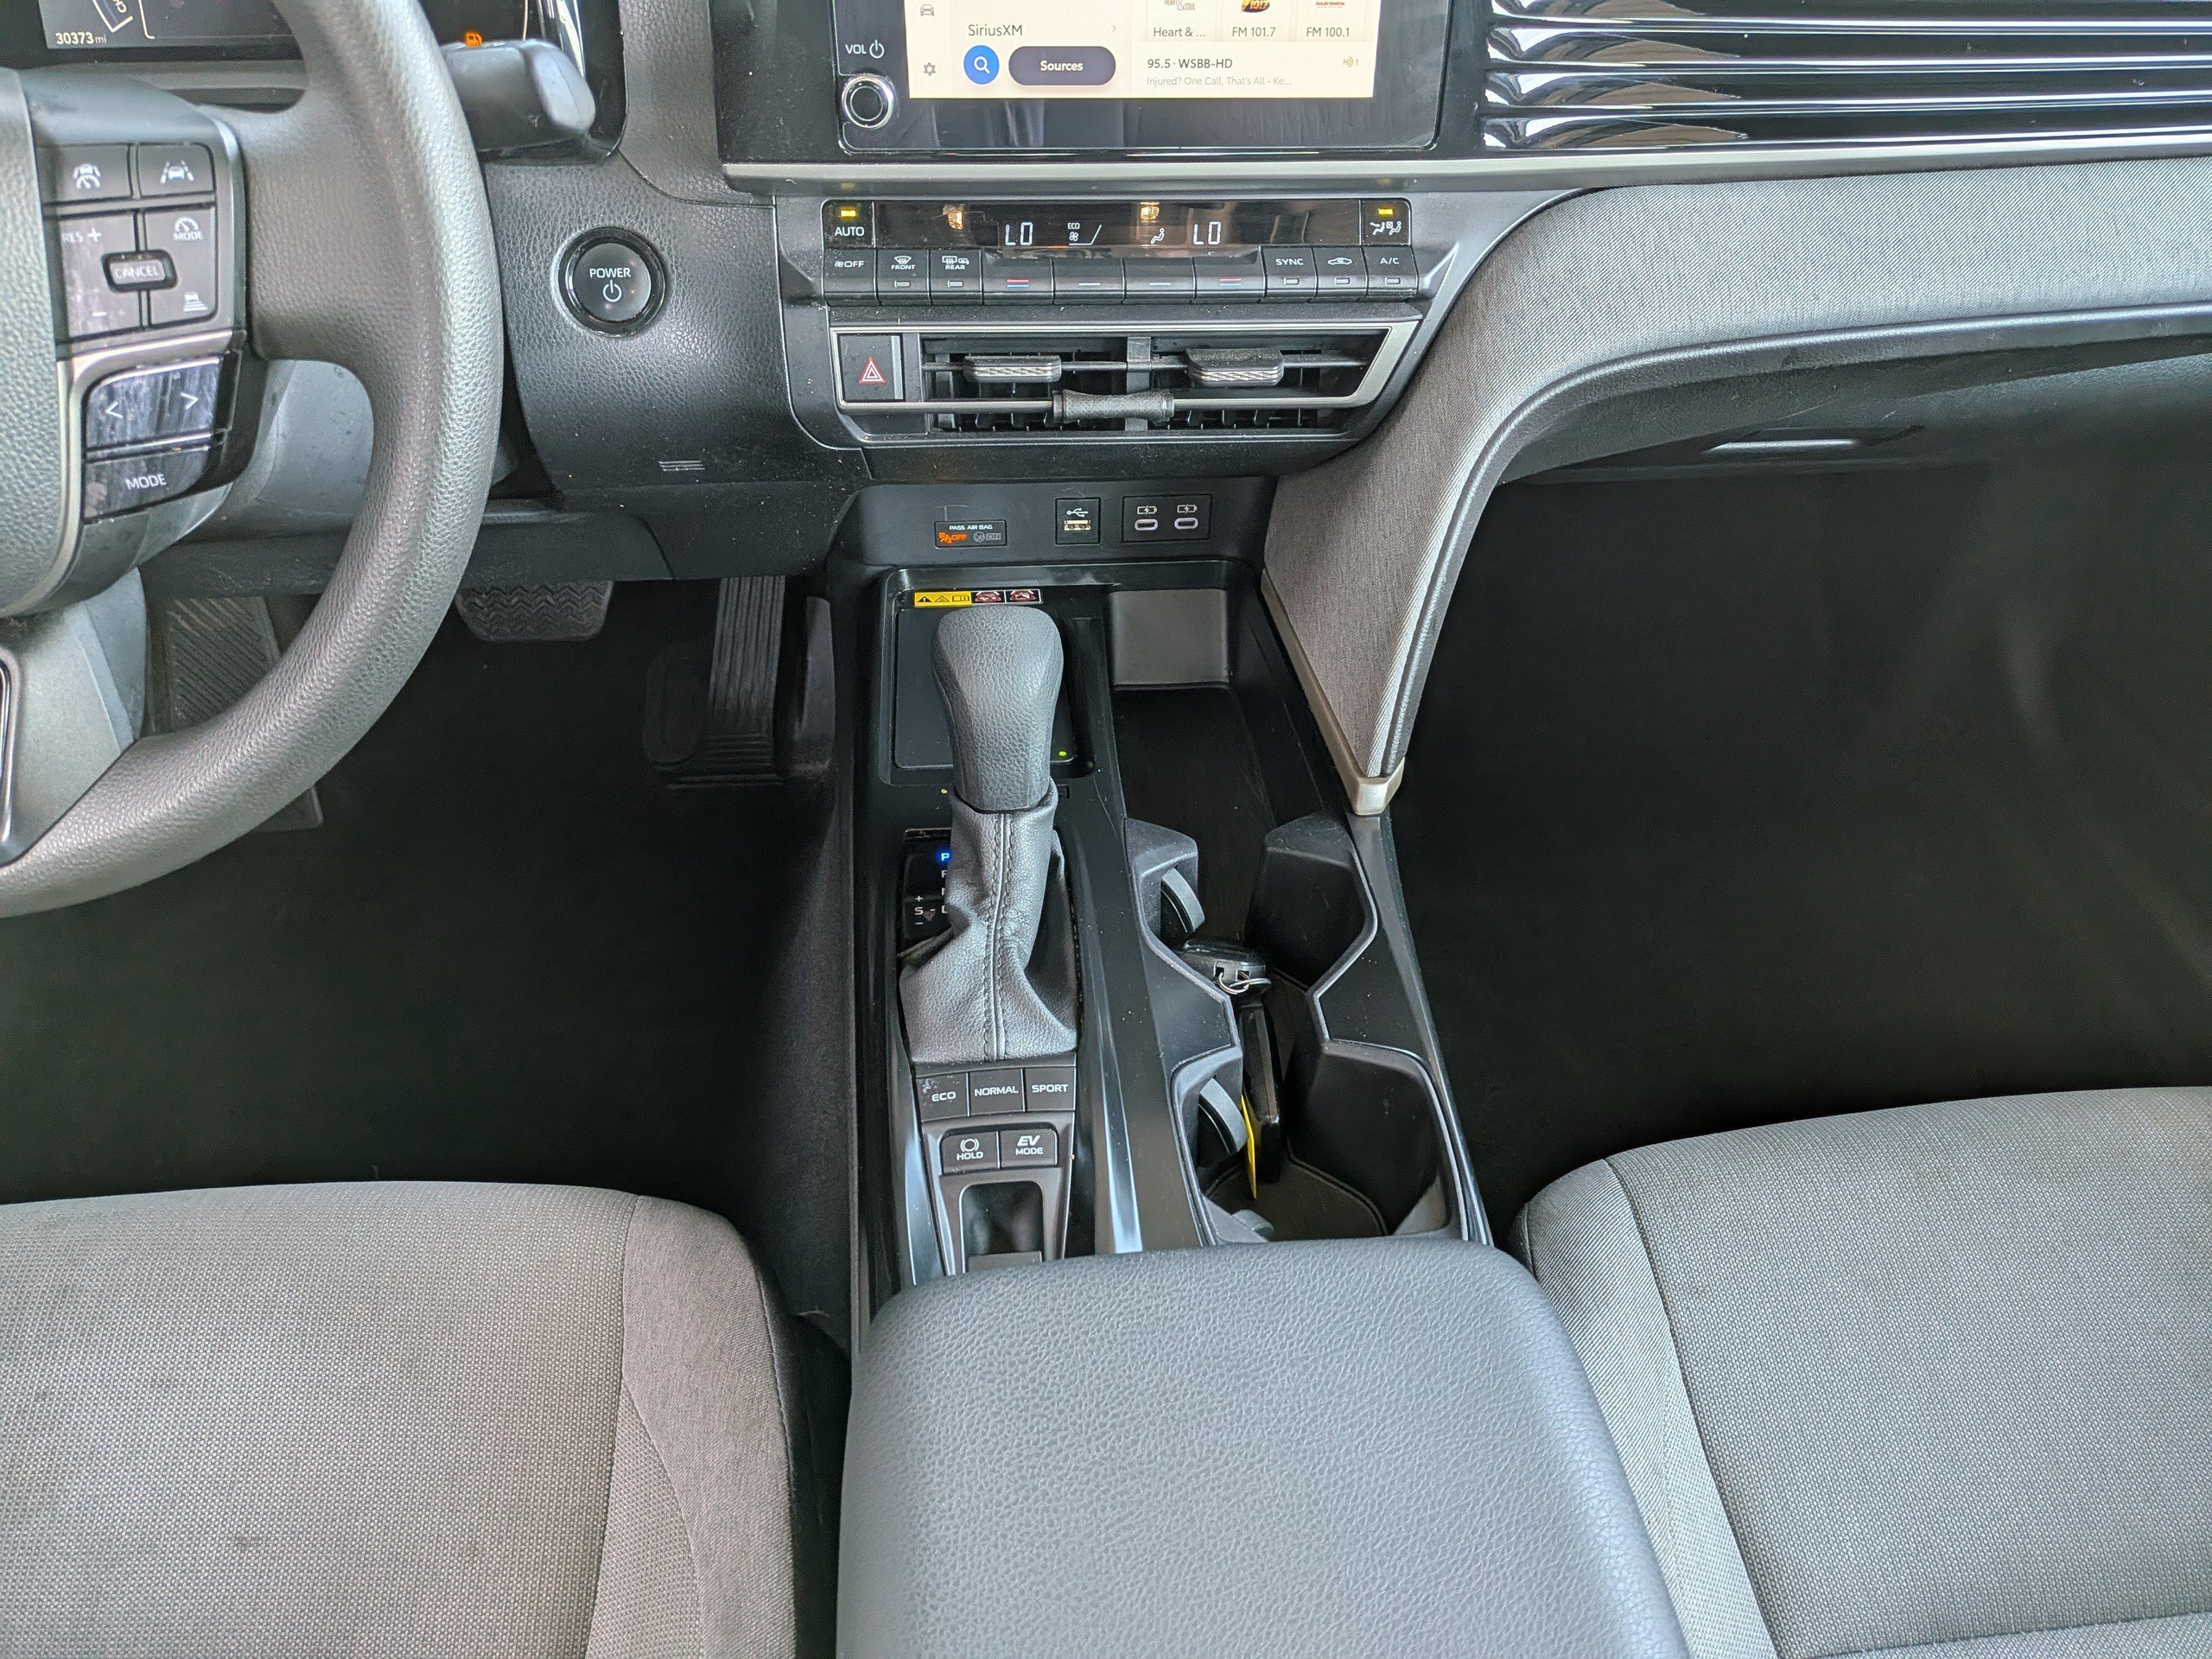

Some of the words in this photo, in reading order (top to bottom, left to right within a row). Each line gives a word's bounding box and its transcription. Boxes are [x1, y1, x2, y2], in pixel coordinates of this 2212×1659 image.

[968, 23, 1023, 37] SiriusXM
[1153, 27, 1184, 37] Heart
[1185, 27, 1193, 37] &
[1231, 27, 1247, 37] FM
[1251, 27, 1276, 37] 101.7
[1306, 27, 1322, 37] FM
[1325, 27, 1350, 37] 100.1
[55, 31, 94, 45] 30373
[94, 35, 107, 43] mi
[845, 44, 867, 54] VOL
[1039, 60, 1084, 72] Sources
[1147, 58, 1171, 68] 95.5
[1179, 58, 1233, 68] WSBB-HD
[1147, 77, 1182, 87] Injured?
[1184, 77, 1203, 86] One
[1205, 77, 1224, 87] Call,
[1227, 77, 1251, 86] That's
[1253, 77, 1266, 86] All
[174, 231, 203, 241] MODE
[835, 226, 865, 237] AUTO
[61, 232, 84, 243] RES
[1380, 257, 1400, 265] A/C
[115, 265, 160, 279] CANCEL
[589, 267, 632, 278] POWER
[125, 473, 168, 490] MODE
[941, 852, 950, 861] P
[974, 1085, 1020, 1096] NORMAL
[1031, 1084, 1069, 1093] SPORT
[931, 1090, 957, 1103] ECO
[1017, 1135, 1041, 1147] EV
[957, 1151, 984, 1161] HOLD
[1015, 1147, 1044, 1156] MODE
